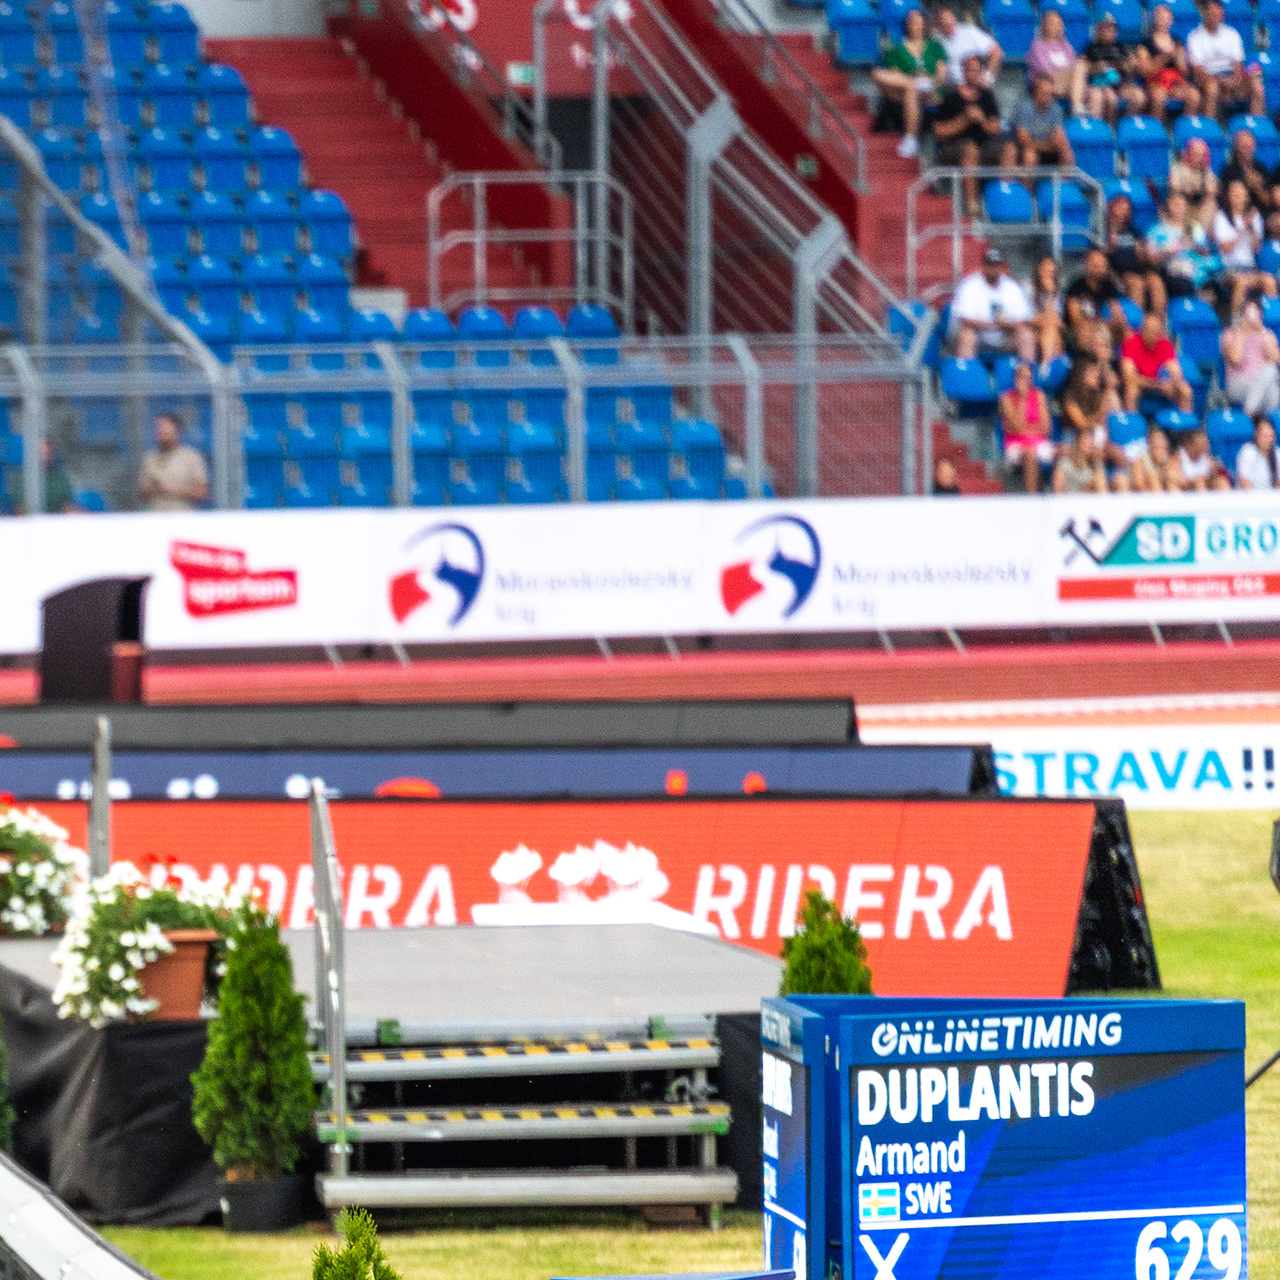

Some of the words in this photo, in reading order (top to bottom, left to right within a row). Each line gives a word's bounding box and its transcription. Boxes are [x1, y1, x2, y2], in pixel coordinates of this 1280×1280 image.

[1136, 521, 1190, 560] SD
[1206, 523, 1279, 554] GRO
[692, 864, 1012, 940] RIDERA
[871, 1012, 1123, 1057] ONLINETIMING
[857, 1061, 1095, 1126] DUPLANTIS
[856, 1130, 966, 1177] Armand
[905, 1181, 952, 1215] SWE
